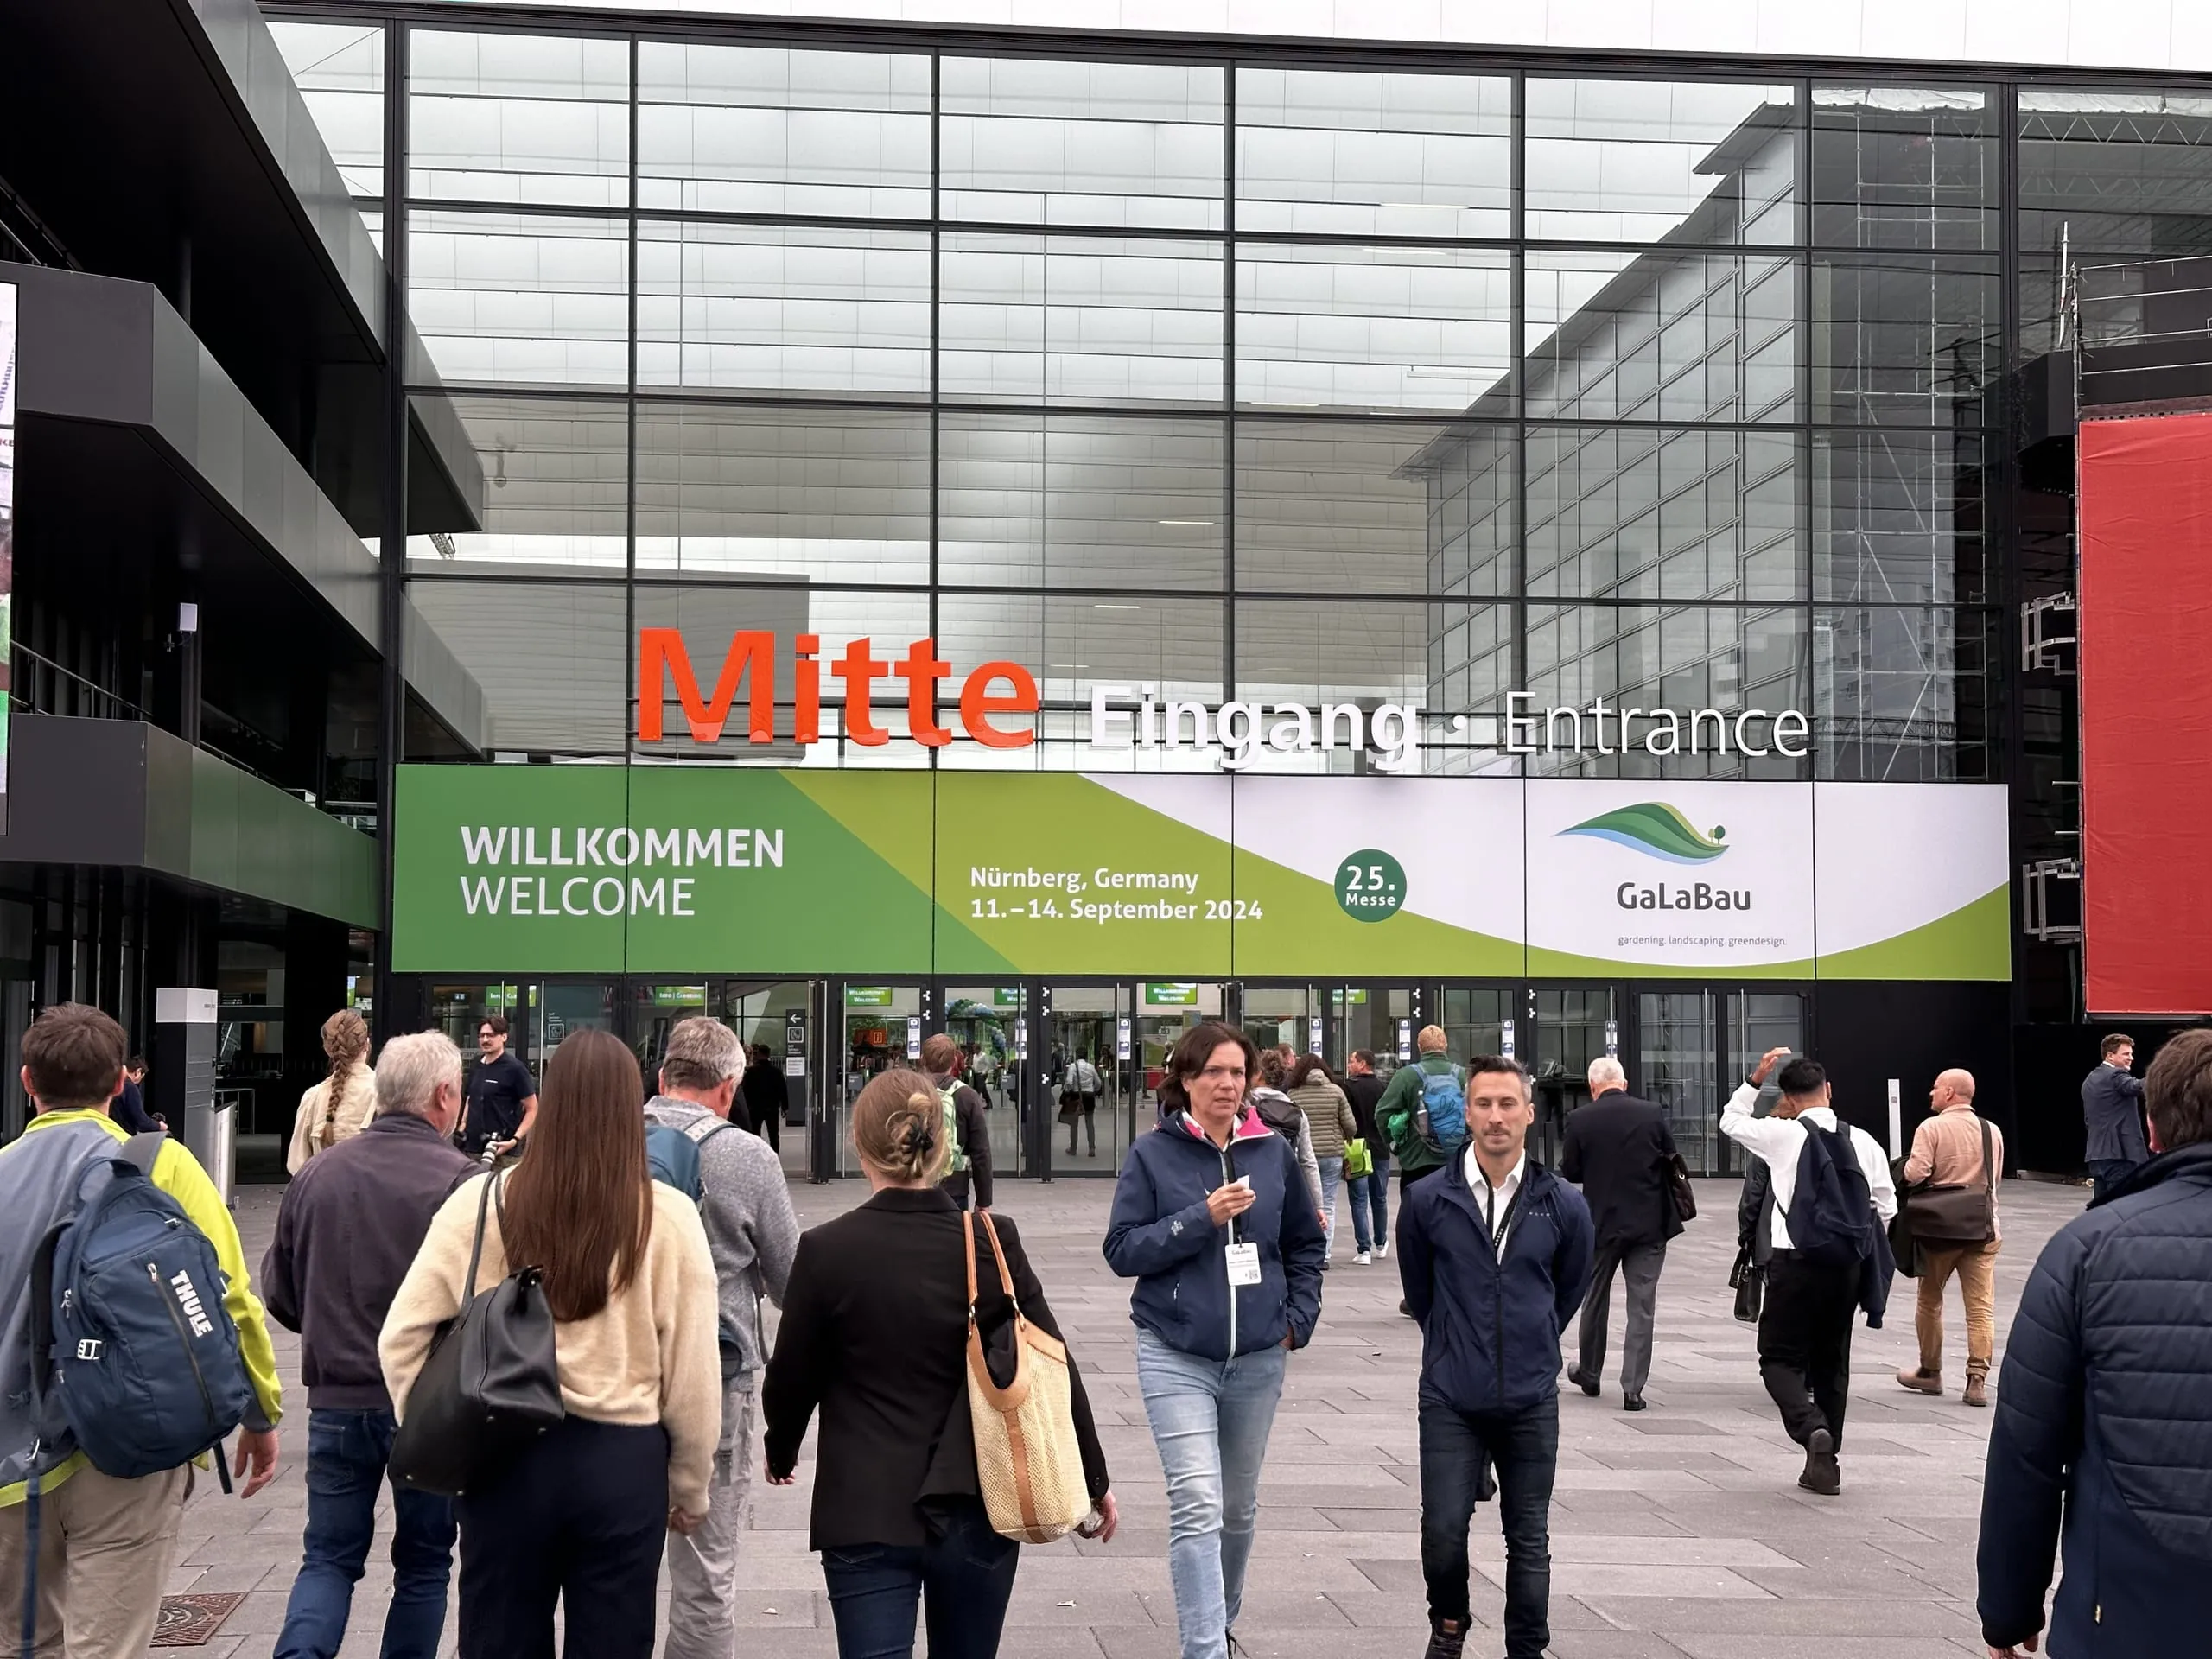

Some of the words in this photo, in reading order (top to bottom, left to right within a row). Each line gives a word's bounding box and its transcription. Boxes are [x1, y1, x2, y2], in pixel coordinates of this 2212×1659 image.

[639, 627, 1039, 748] Mitte
[1090, 684, 1417, 771] Eingang
[1504, 690, 1809, 759] Entrance
[461, 826, 784, 868] WILLKOMMEN
[970, 867, 1088, 893] Nürnberg,
[1094, 868, 1199, 894] Germany
[1345, 865, 1396, 891] 25.
[461, 876, 695, 916] WELCOME
[1070, 899, 1199, 924] September
[1204, 899, 1263, 920] 2024
[1345, 892, 1396, 906] Messe
[1616, 881, 1751, 911] GaLaBau
[170, 1269, 213, 1338] THULE
